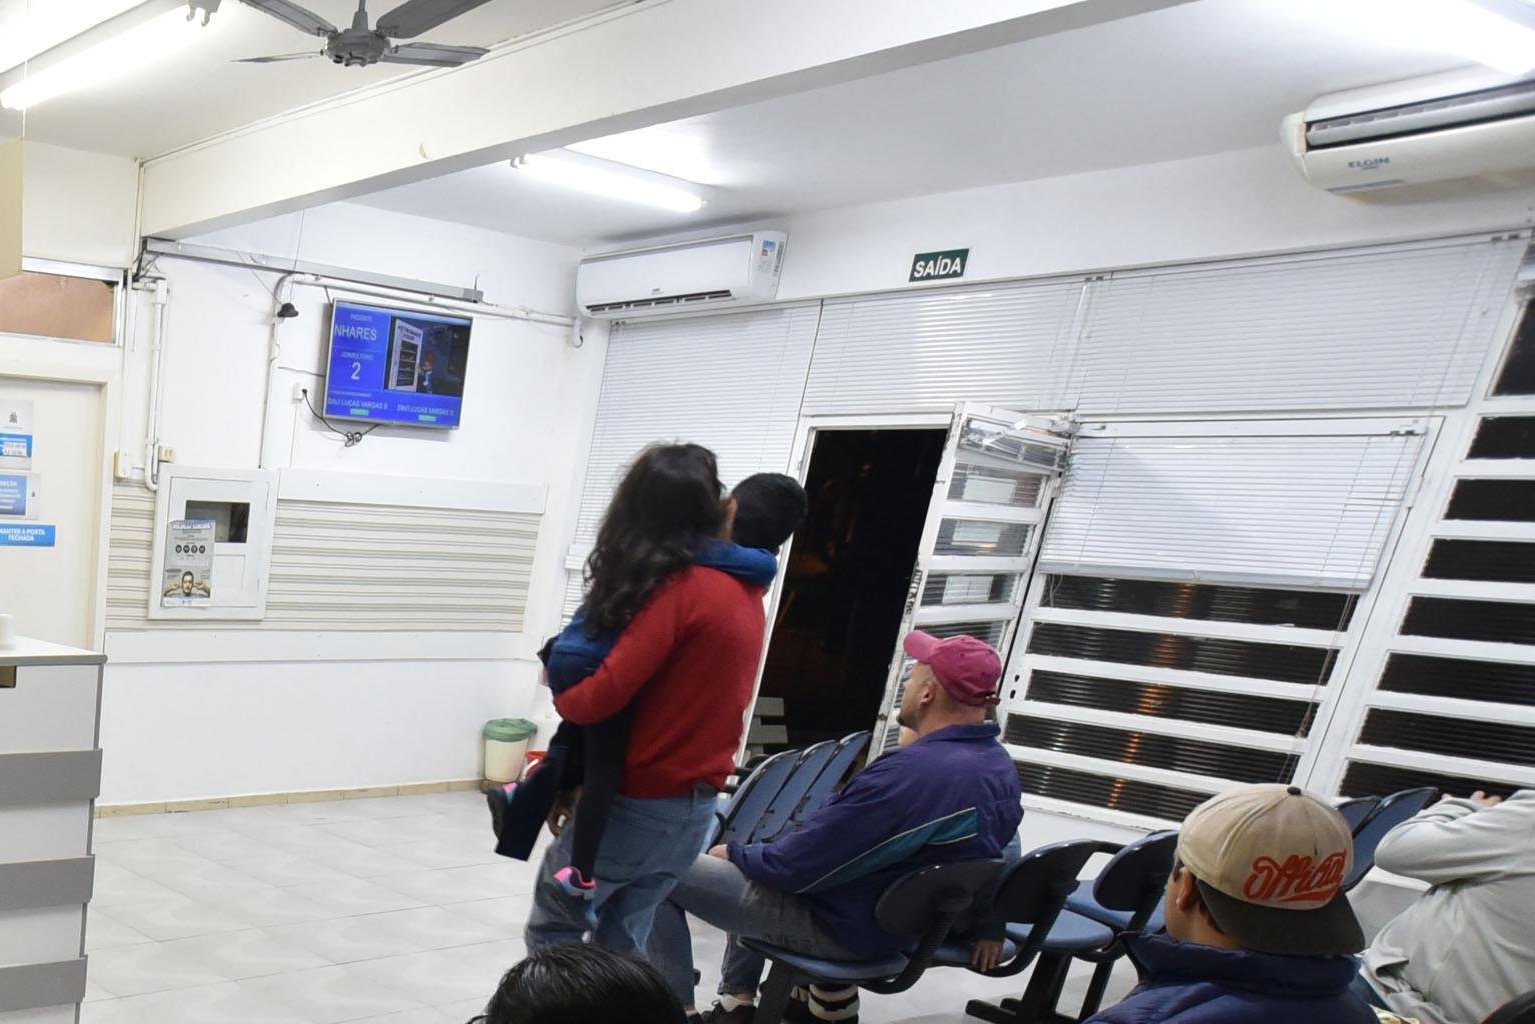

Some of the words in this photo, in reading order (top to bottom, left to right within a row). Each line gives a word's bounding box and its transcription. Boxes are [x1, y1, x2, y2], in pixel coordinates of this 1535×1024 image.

[913, 255, 962, 278] SAÍDA
[350, 361, 362, 380] 2
[8, 534, 35, 542] FECHADA
[26, 528, 46, 536] PORTA
